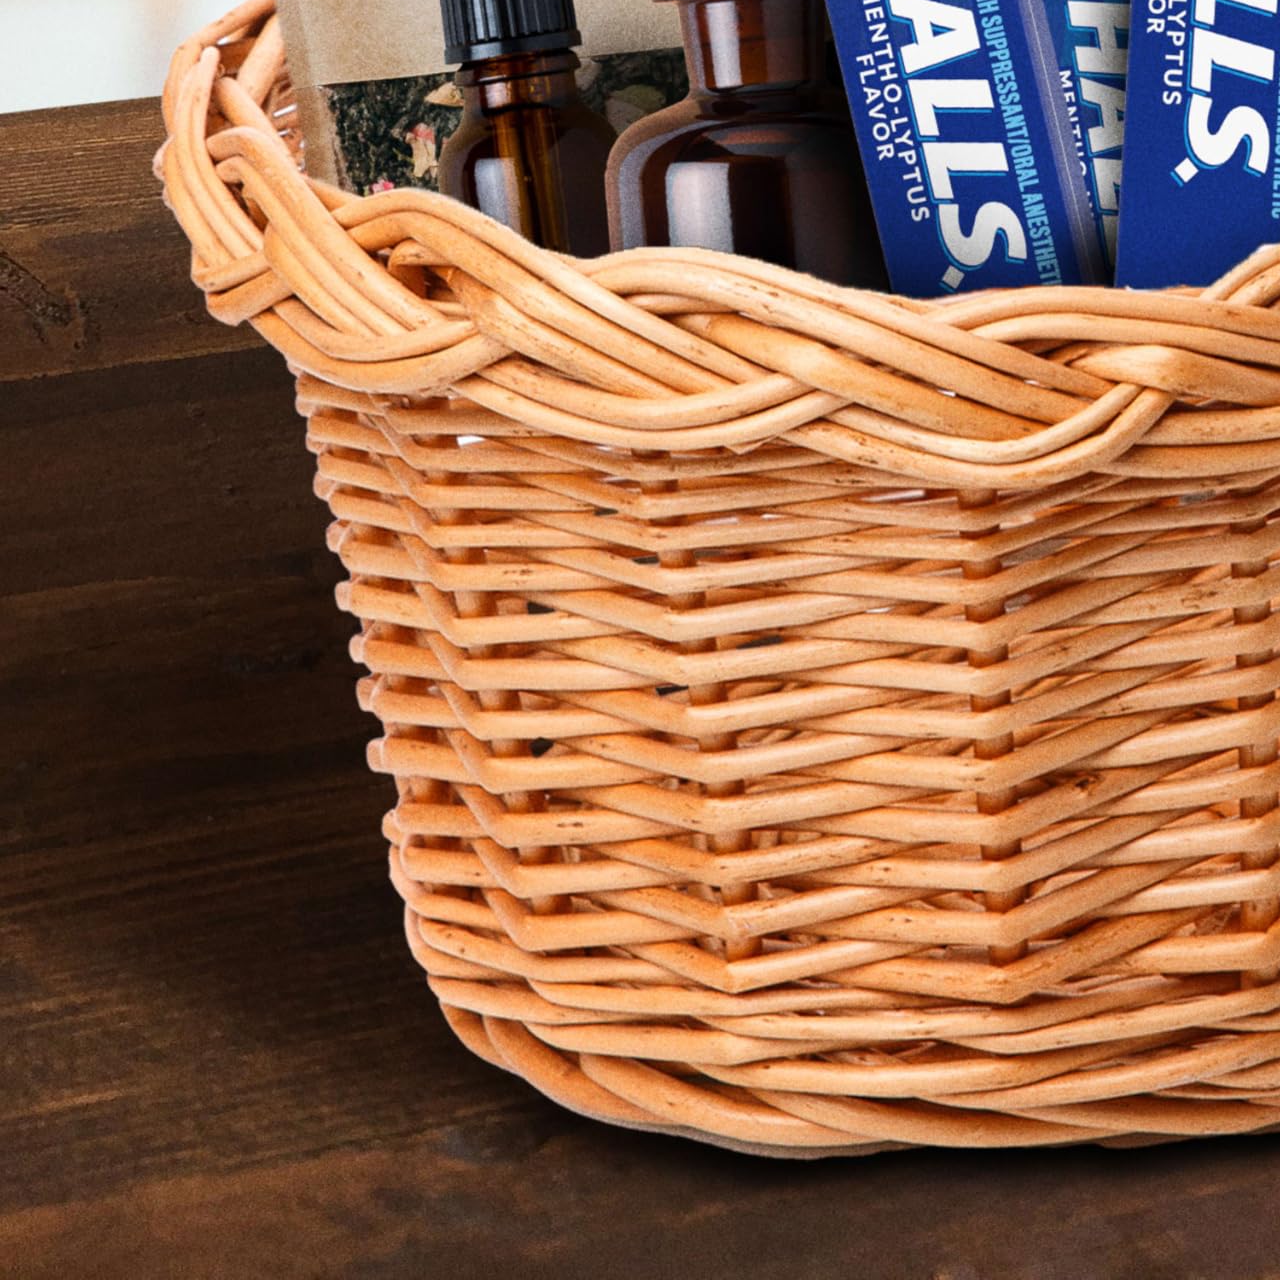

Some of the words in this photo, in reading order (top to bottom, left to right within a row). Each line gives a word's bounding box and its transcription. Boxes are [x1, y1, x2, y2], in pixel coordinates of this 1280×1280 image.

[856, 53, 895, 161] FLAVOR
[980, 15, 1040, 193] SUPPRESSANT/ORAL
[1021, 193, 1063, 286] ANESTHETI
